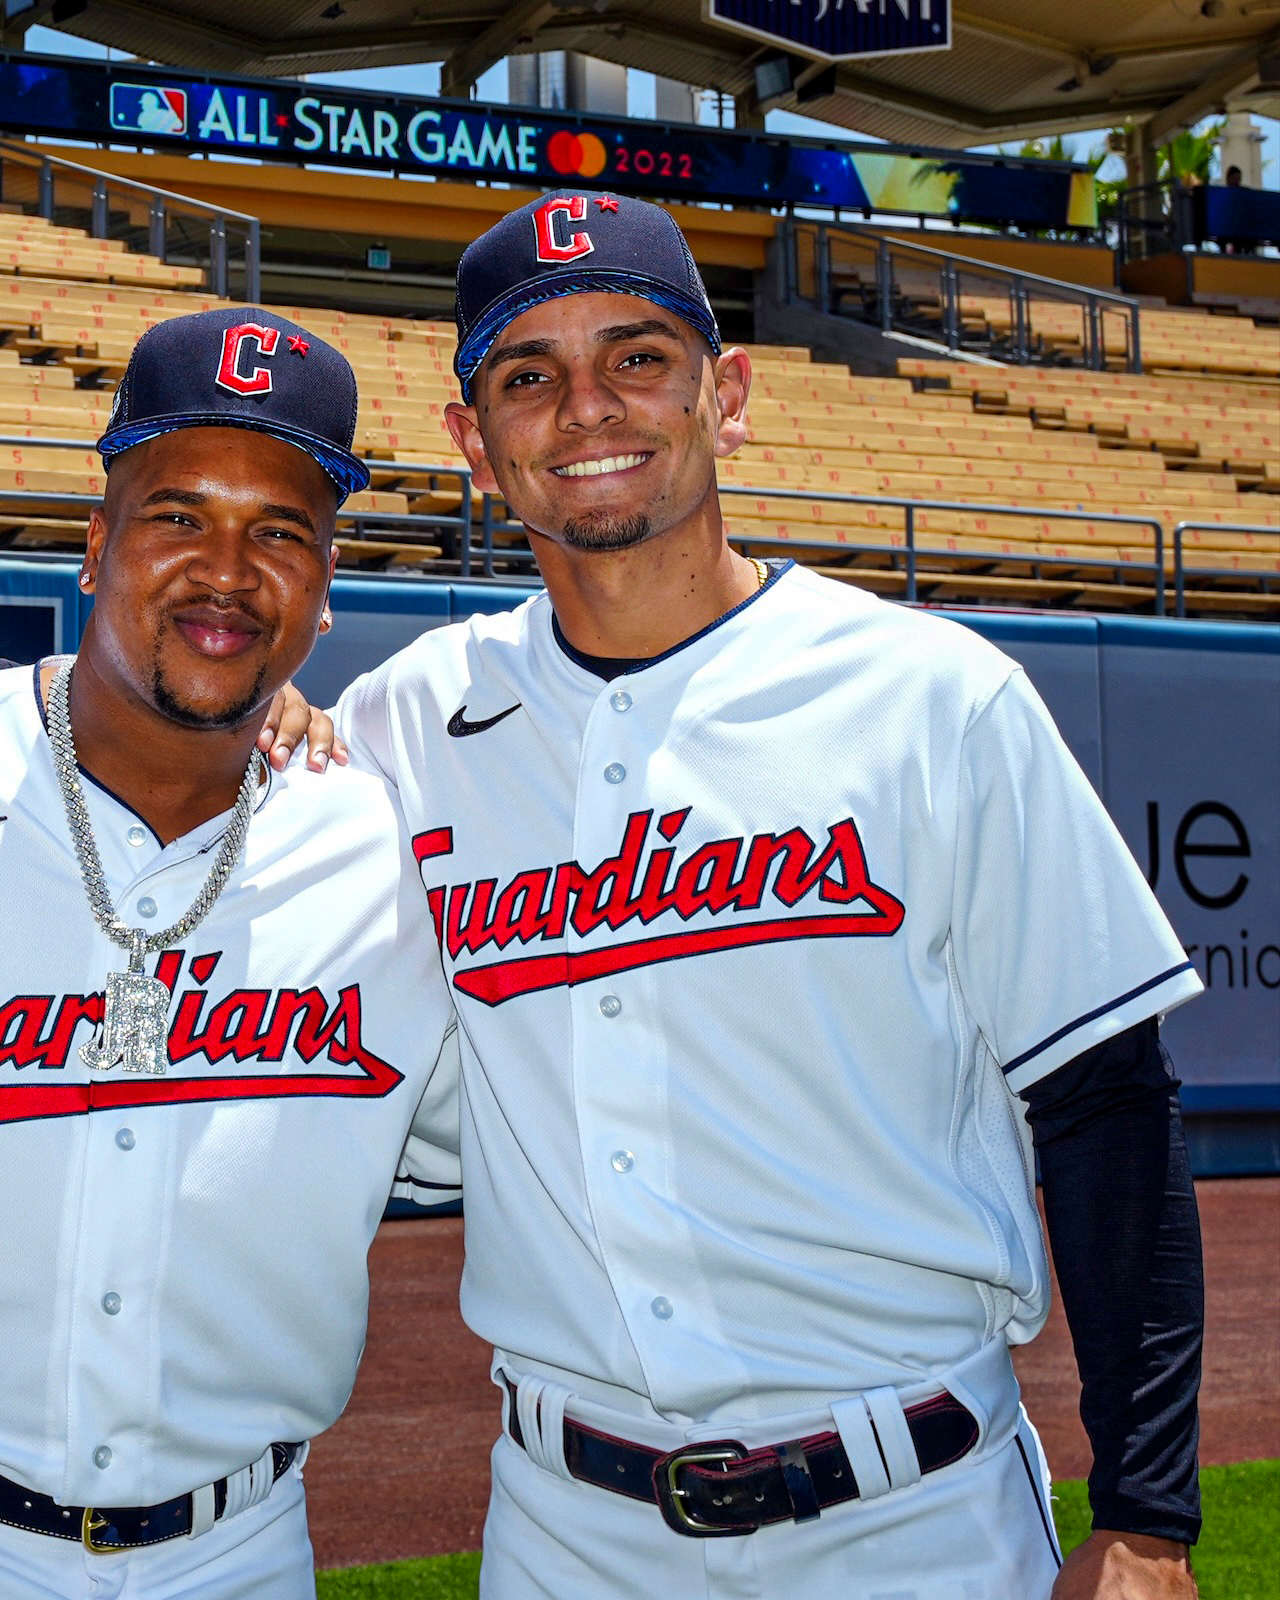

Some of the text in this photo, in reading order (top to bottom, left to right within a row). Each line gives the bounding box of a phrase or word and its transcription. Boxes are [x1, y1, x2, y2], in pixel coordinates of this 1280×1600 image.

[198, 87, 694, 180] ALL STAR GAME 2022
[531, 195, 596, 265] C
[215, 322, 281, 397] C
[39, 370, 46, 385] 1
[32, 386, 41, 404] 2
[12, 448, 24, 464] 5
[86, 454, 95, 469] 4
